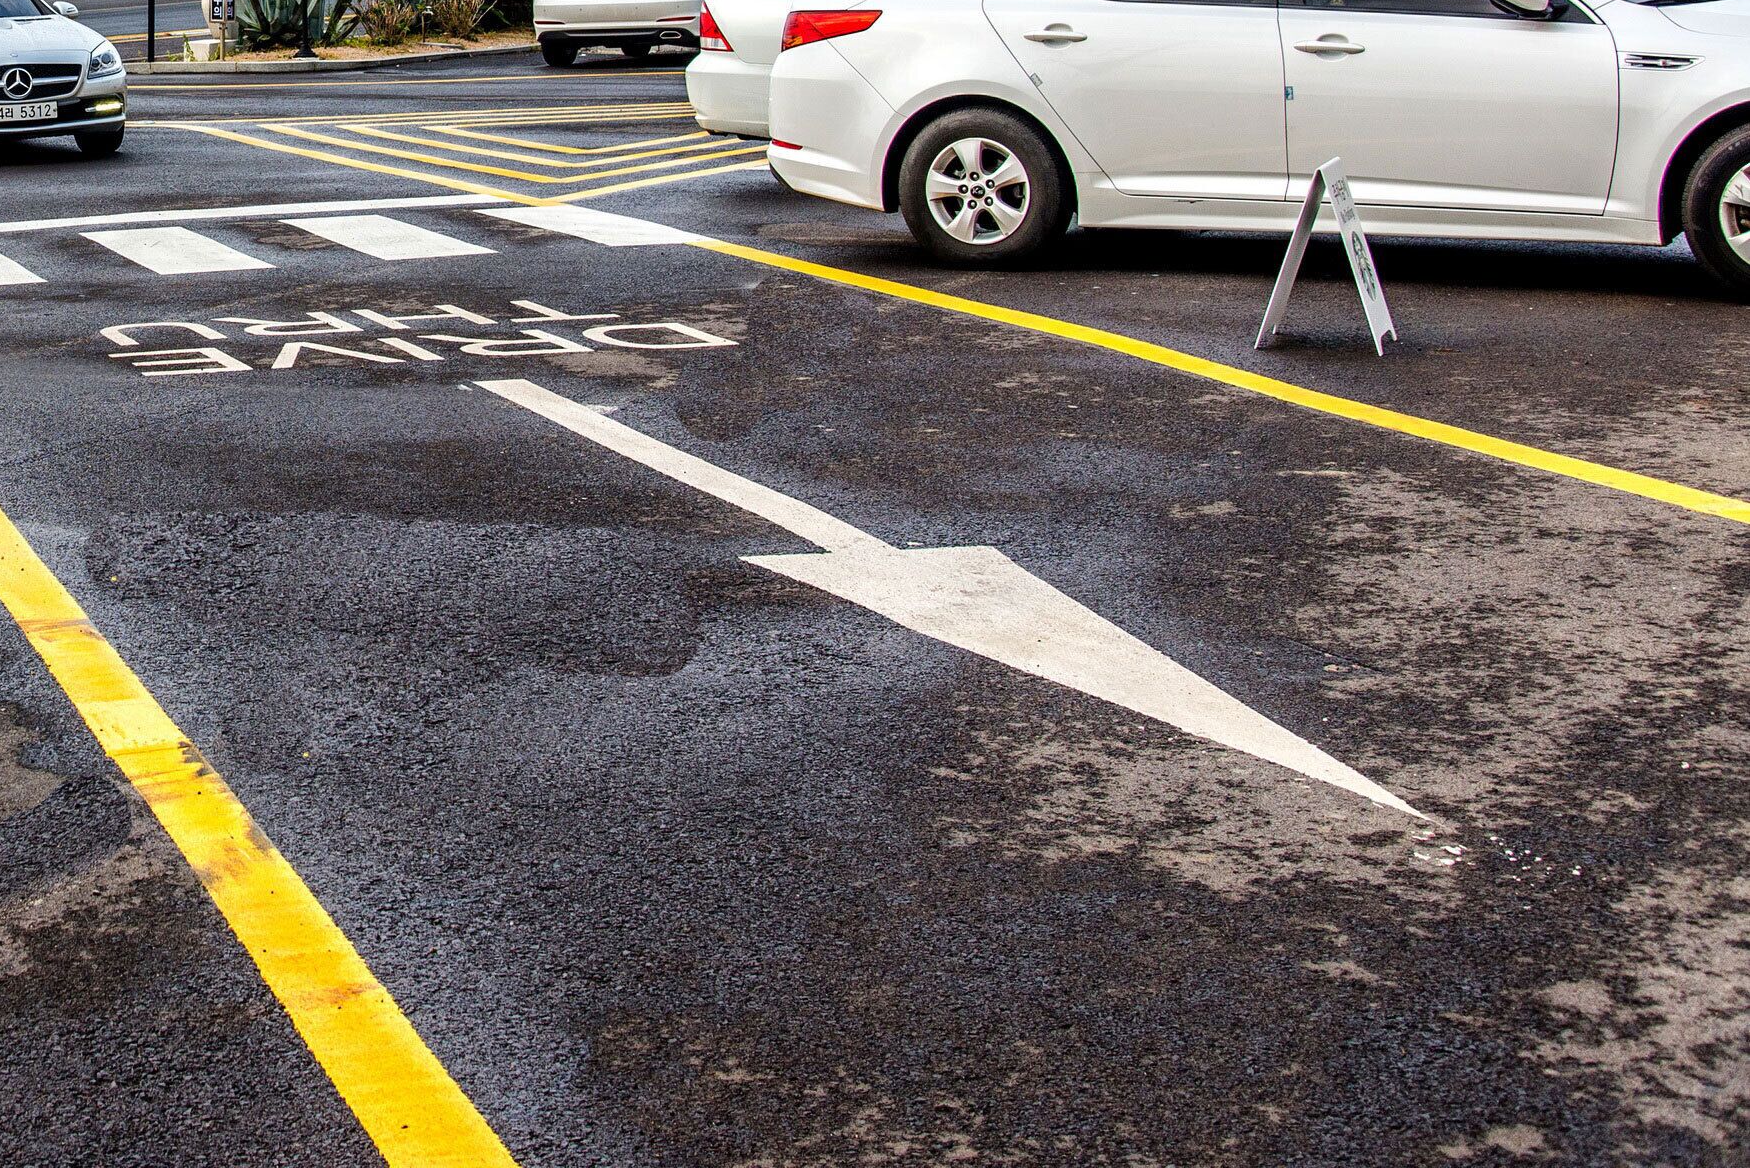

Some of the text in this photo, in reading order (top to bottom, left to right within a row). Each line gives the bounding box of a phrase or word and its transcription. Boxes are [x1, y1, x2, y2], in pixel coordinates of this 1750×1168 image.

[20, 103, 52, 119] 5312
[100, 299, 623, 346] THRU
[107, 320, 741, 379] DRIVE
